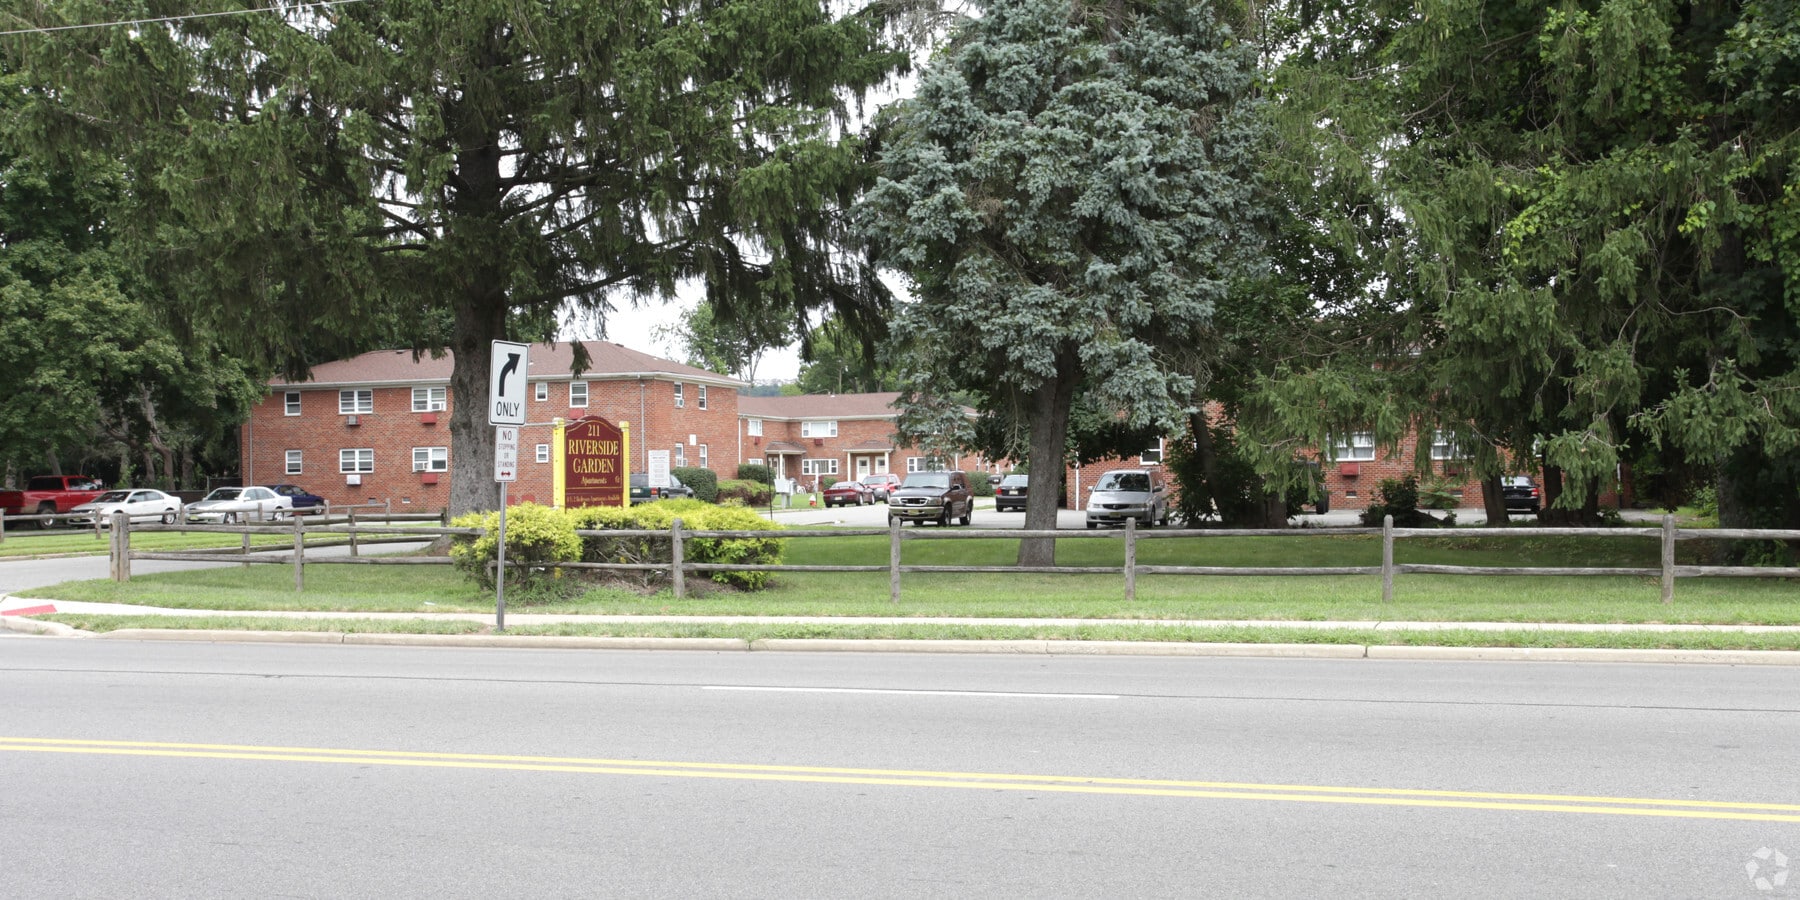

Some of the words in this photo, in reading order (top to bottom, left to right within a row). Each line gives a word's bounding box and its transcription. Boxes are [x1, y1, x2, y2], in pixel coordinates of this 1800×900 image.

[496, 401, 520, 417] ONLY
[502, 430, 512, 441] NO
[587, 424, 600, 437] 211
[568, 439, 619, 455] RIVERSIDE
[573, 457, 615, 474] GARDEN
[581, 475, 607, 486] Apartments
